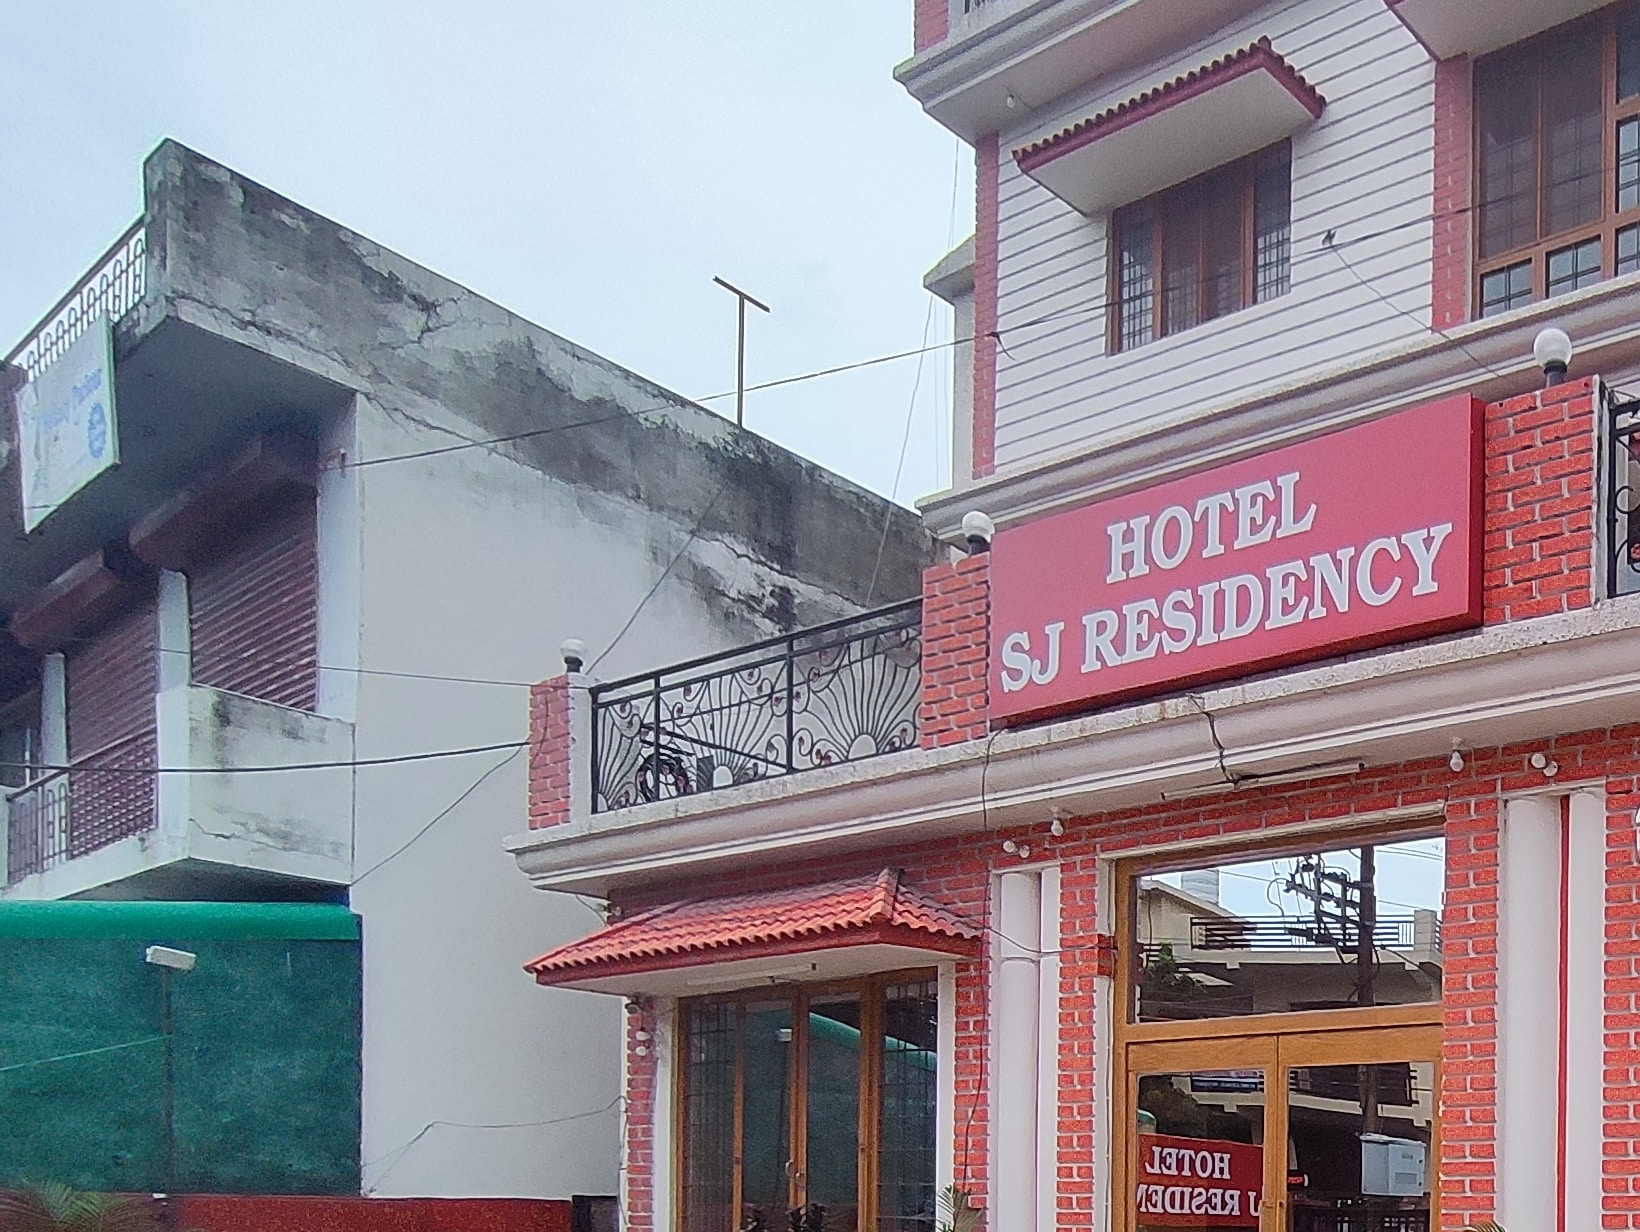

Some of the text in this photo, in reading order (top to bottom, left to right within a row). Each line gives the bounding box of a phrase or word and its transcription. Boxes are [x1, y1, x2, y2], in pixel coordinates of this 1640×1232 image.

[1106, 471, 1318, 585] HOTEL
[1000, 523, 1453, 693] SJ RESIDENCY
